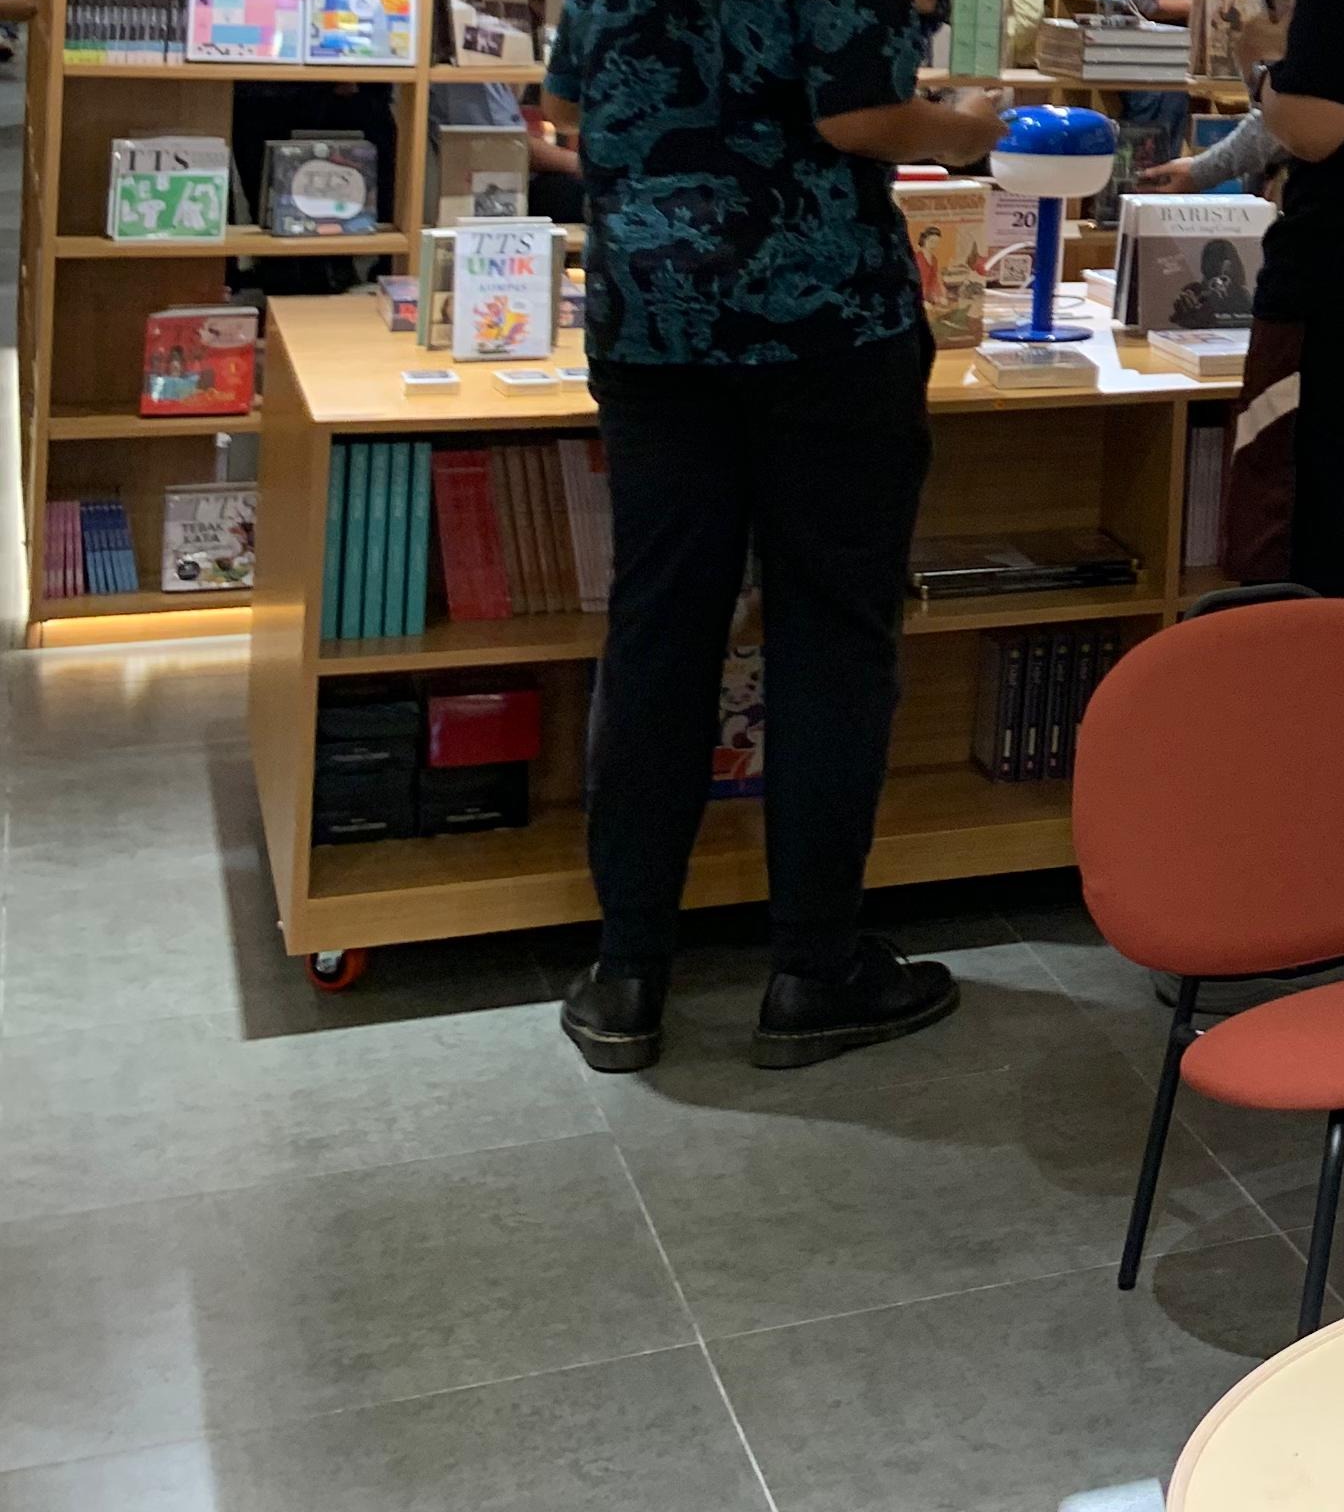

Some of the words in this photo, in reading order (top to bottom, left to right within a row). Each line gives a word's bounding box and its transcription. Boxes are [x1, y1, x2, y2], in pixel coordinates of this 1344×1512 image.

[1160, 208, 1250, 222] BARISTA
[472, 233, 534, 254] TTS
[467, 255, 535, 276] UNIK
